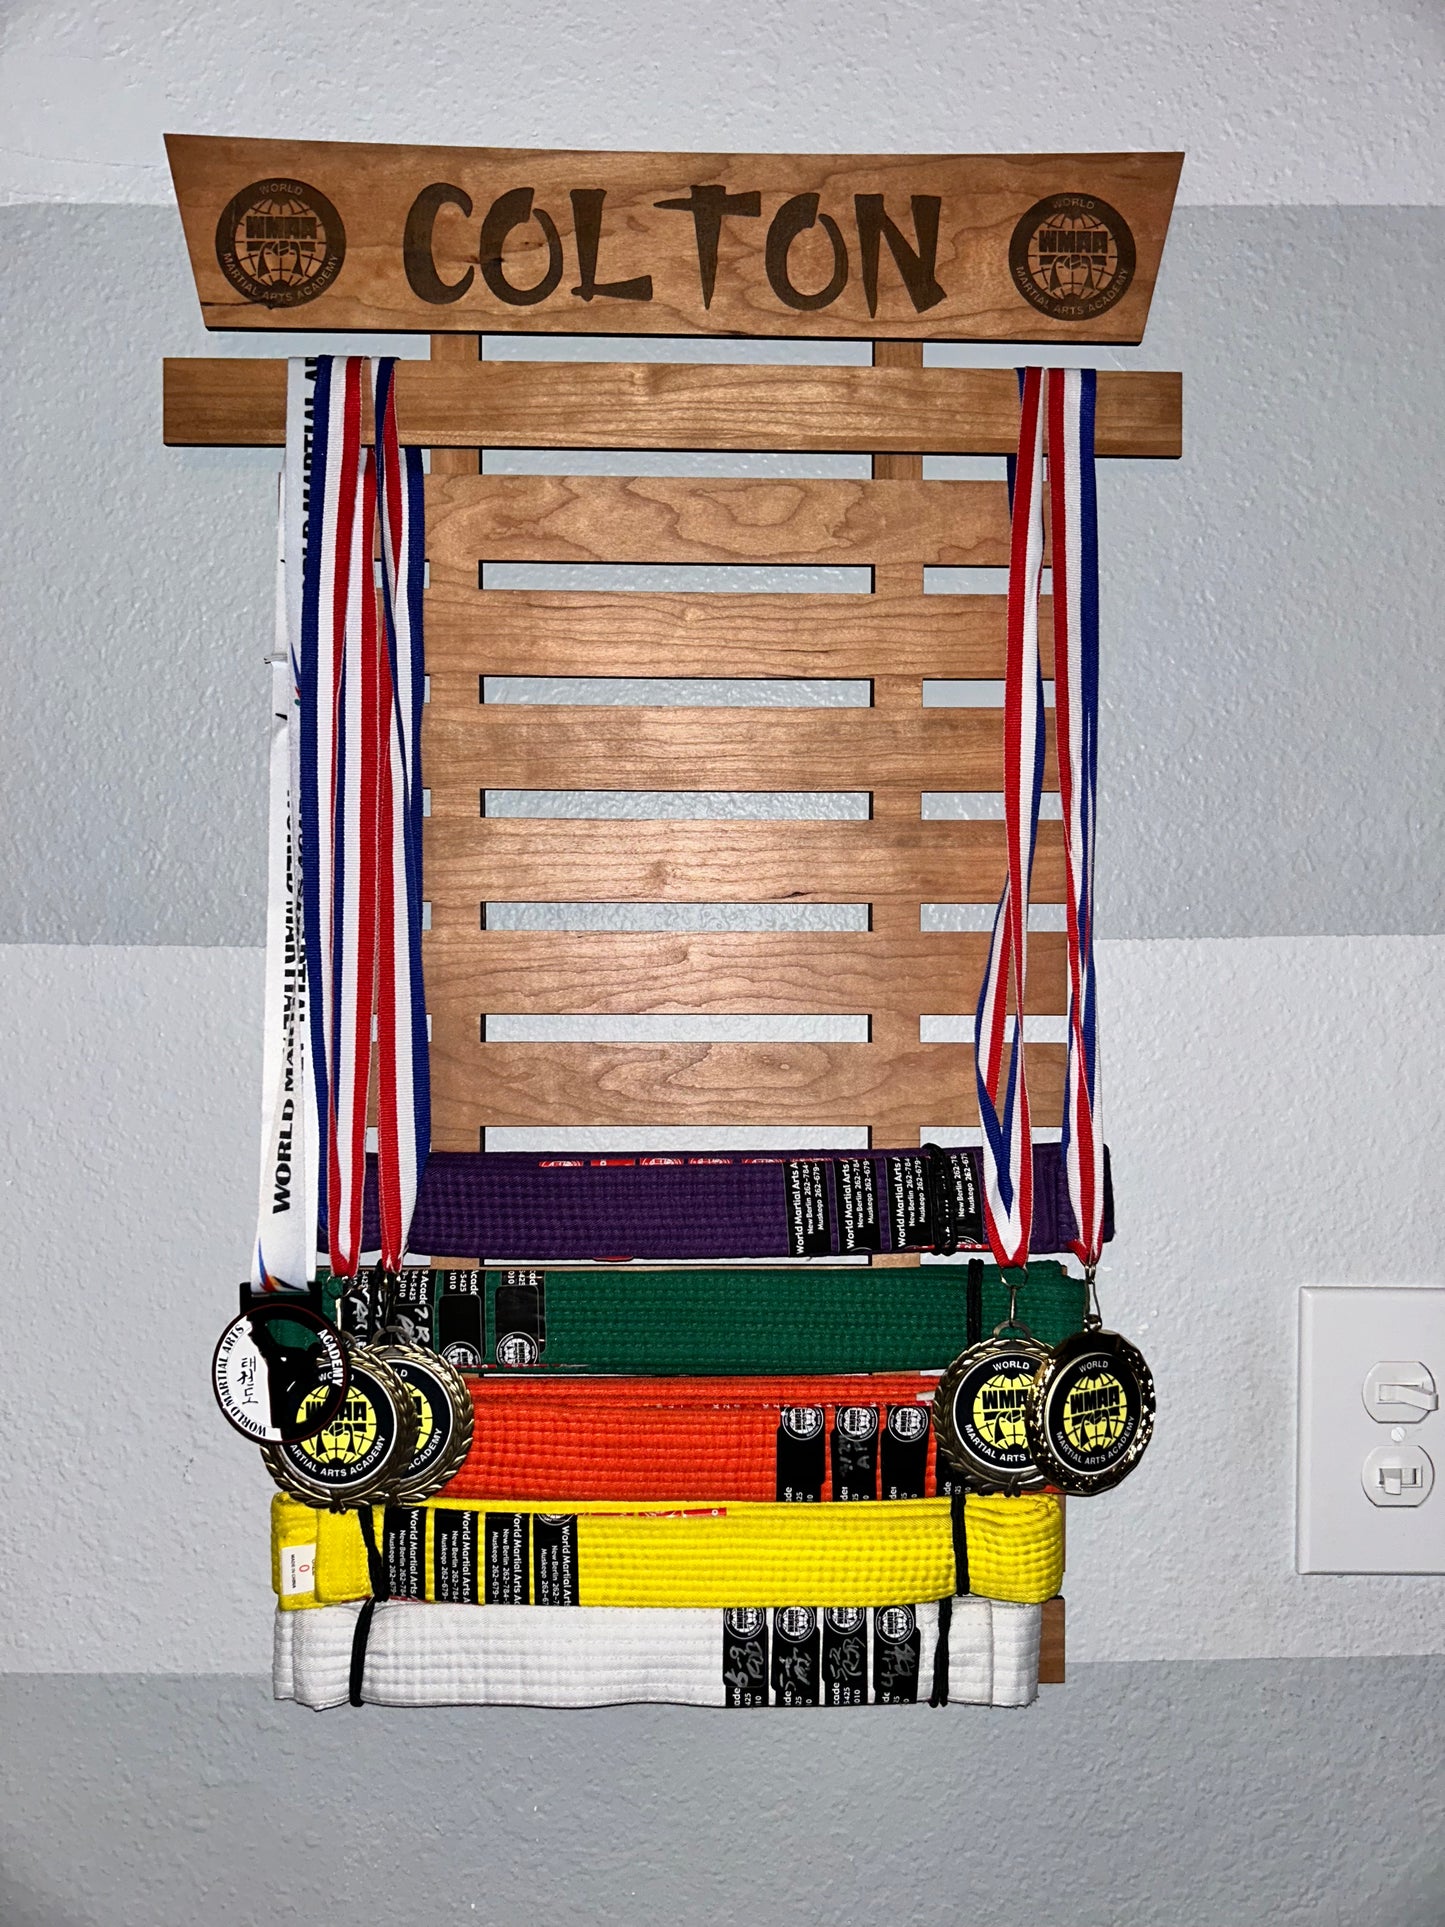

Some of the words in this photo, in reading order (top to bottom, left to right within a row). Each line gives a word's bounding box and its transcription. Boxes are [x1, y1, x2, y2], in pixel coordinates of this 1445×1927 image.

[259, 183, 303, 196] WORLD
[1053, 198, 1095, 210] WORLD
[403, 182, 947, 318] COLTON
[223, 253, 257, 296] MARTIAL
[262, 291, 293, 301] ARTS
[298, 254, 338, 299] ACADEMY
[1016, 266, 1049, 309] MARTIAL
[1054, 305, 1084, 315] ARTS
[1088, 268, 1128, 312] ACADEMY
[272, 1098, 295, 1214] WORLD
[791, 1170, 801, 1189] Arts
[842, 1163, 851, 1183] Arts
[893, 1163, 903, 1182] Arts
[842, 1184, 853, 1218] Martial
[855, 1191, 863, 1212] Berlin
[894, 1183, 905, 1217] Martial
[907, 1190, 915, 1211] Berlin
[955, 1181, 964, 1201] Berlin
[968, 1183, 976, 1213] Muskego
[792, 1191, 803, 1224] Martial
[805, 1197, 813, 1218] Berlin
[816, 1199, 824, 1230] Muskego
[908, 1211, 916, 1226] New
[918, 1193, 926, 1223] Muskego
[795, 1225, 805, 1255] World
[845, 1219, 855, 1249] World
[896, 1219, 906, 1247] World
[222, 1325, 244, 1353] ARTS
[317, 1328, 344, 1387] ACADEMY
[992, 1360, 1030, 1372] WORLD
[1079, 1360, 1109, 1373] WORLD
[217, 1357, 234, 1407] MARTIAL
[237, 1355, 259, 1405] 태권도
[1070, 1385, 1120, 1415] WMAA
[230, 1406, 267, 1437] WORLD
[964, 1424, 997, 1459] MARTIAL
[999, 1453, 1027, 1462] ARTS
[1056, 1431, 1082, 1463] MARTIAL
[1084, 1455, 1106, 1465] ARTS
[1107, 1415, 1135, 1459] ACADEMY
[290, 1444, 317, 1473] ARTIAL
[320, 1468, 347, 1477] ARTS
[350, 1435, 386, 1476] ACADEMY
[409, 1509, 420, 1541] World
[451, 1530, 459, 1546] New
[462, 1511, 472, 1541] World
[502, 1528, 510, 1544] New
[561, 1525, 571, 1554] World
[388, 1532, 396, 1563] Muskego
[409, 1541, 418, 1575] Martial
[440, 1533, 448, 1565] Muskego
[451, 1547, 459, 1568] Berlin
[462, 1541, 471, 1576] Martial
[491, 1531, 499, 1563] Muskego
[502, 1545, 510, 1566] Berlin
[513, 1538, 522, 1573] Martial
[540, 1548, 548, 1579] Muskego
[551, 1561, 559, 1581] Berlin
[562, 1555, 572, 1588] Martial
[409, 1575, 418, 1594] Arts
[462, 1576, 471, 1596] Arts
[513, 1573, 522, 1593] Arts
